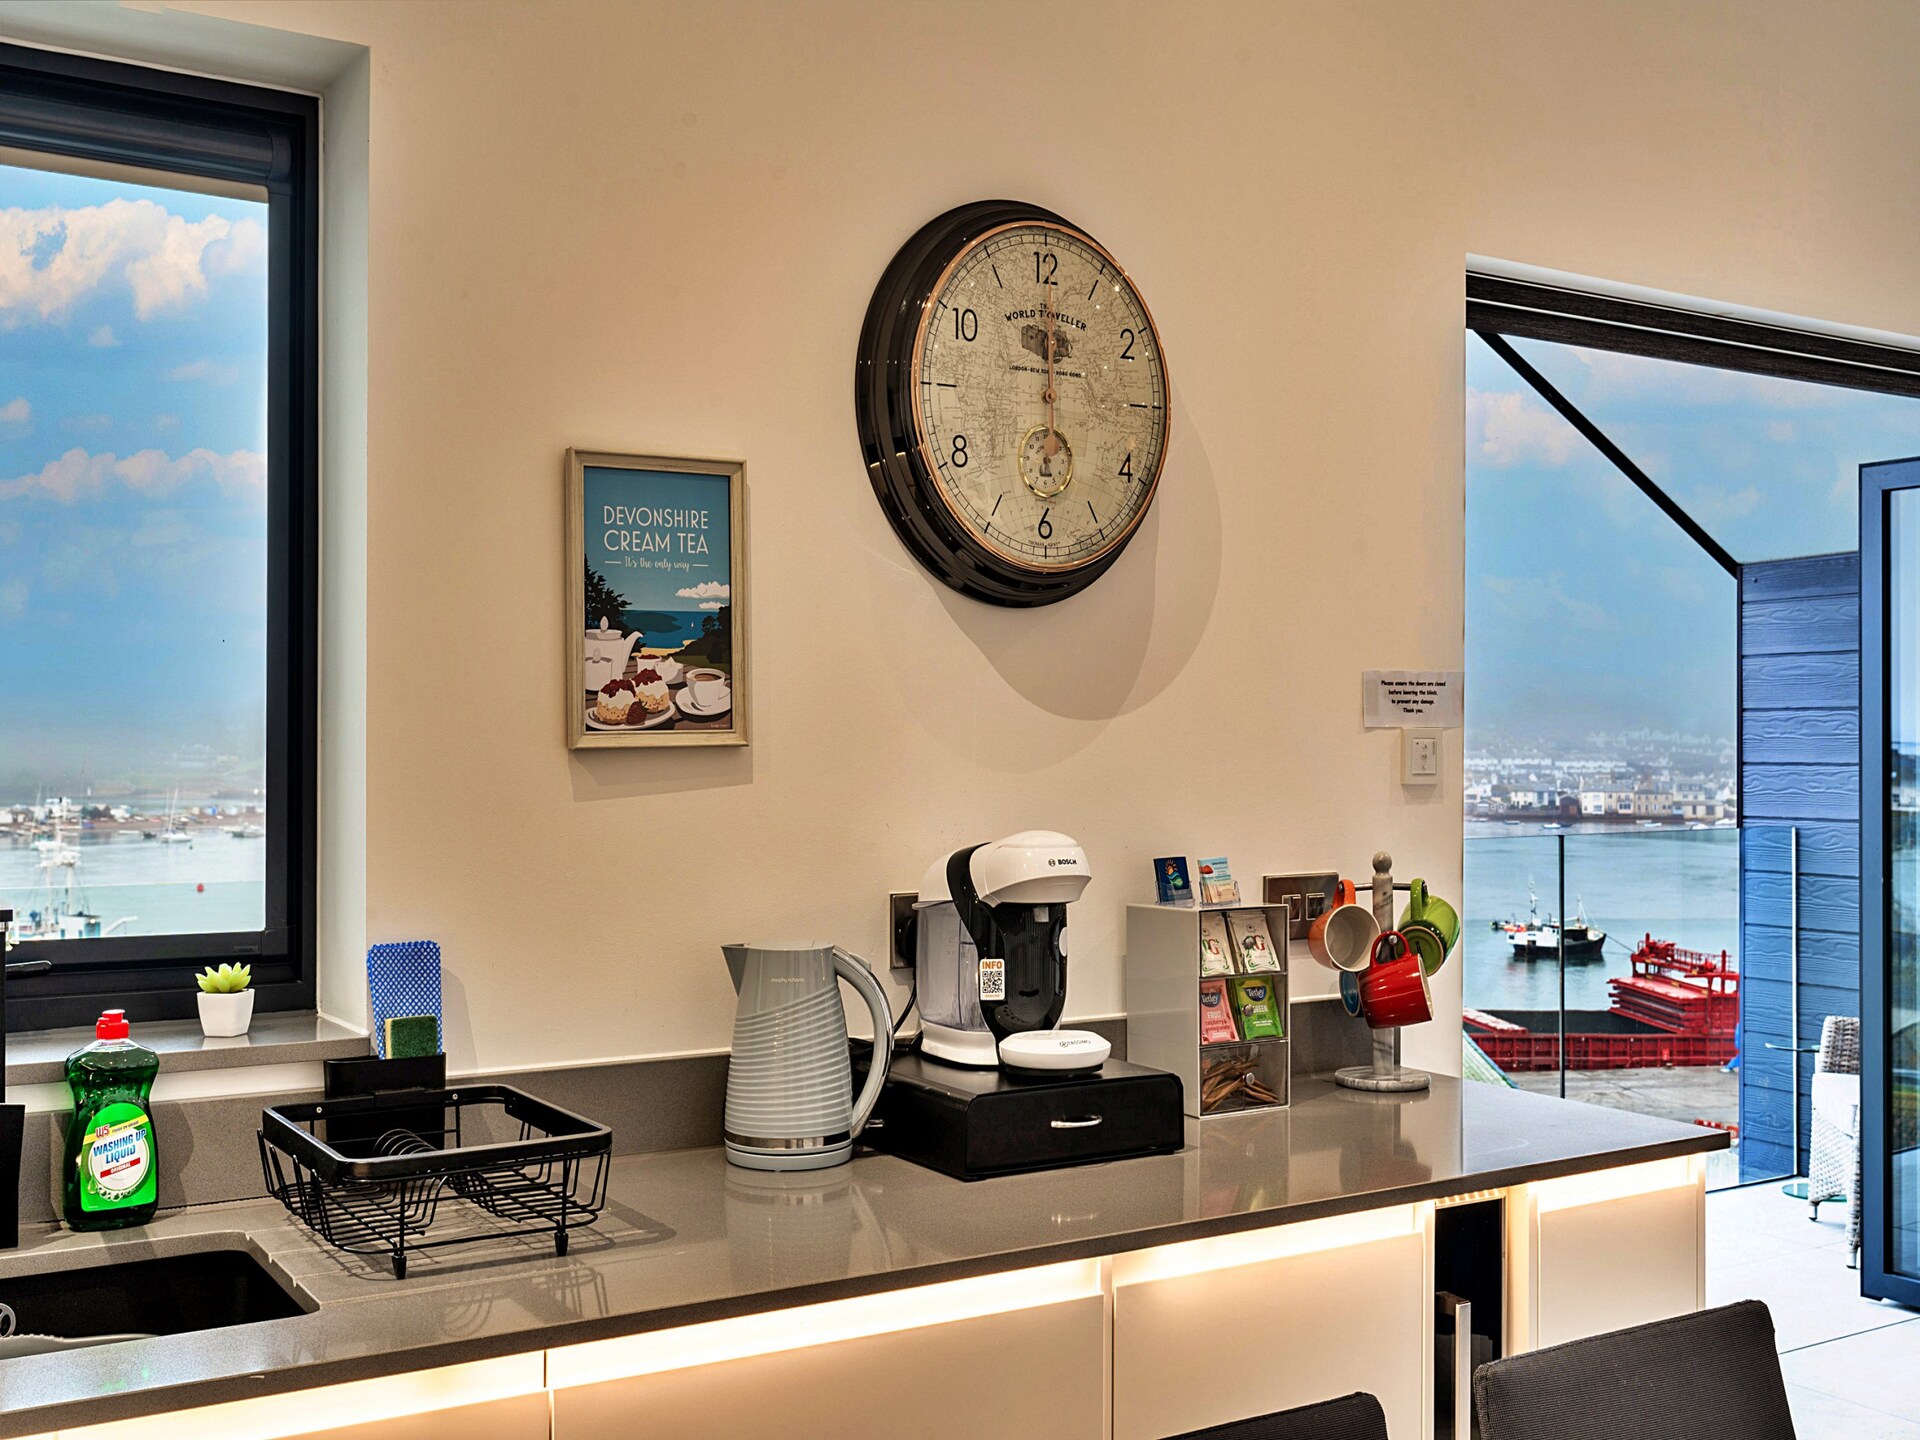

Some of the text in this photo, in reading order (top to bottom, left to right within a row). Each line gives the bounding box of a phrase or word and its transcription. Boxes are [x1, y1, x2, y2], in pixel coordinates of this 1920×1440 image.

[1033, 251, 1058, 286] 12
[952, 307, 978, 342] 10
[1004, 309, 1087, 331] WORLD TVELLER
[1119, 328, 1135, 361] 2
[951, 434, 969, 468] 8
[1118, 452, 1134, 484] 4
[603, 505, 709, 529] DEVONSHIRE
[1037, 507, 1053, 540] 6
[603, 529, 709, 554] CREAM TEA
[624, 555, 690, 572] It's the only way
[1057, 858, 1078, 866] BOSCH
[982, 961, 1003, 970] INFO
[1245, 987, 1265, 999] Tetley
[93, 1128, 147, 1157] WASHING UP
[95, 1124, 110, 1139] W5
[105, 1144, 136, 1164] LIQUID
